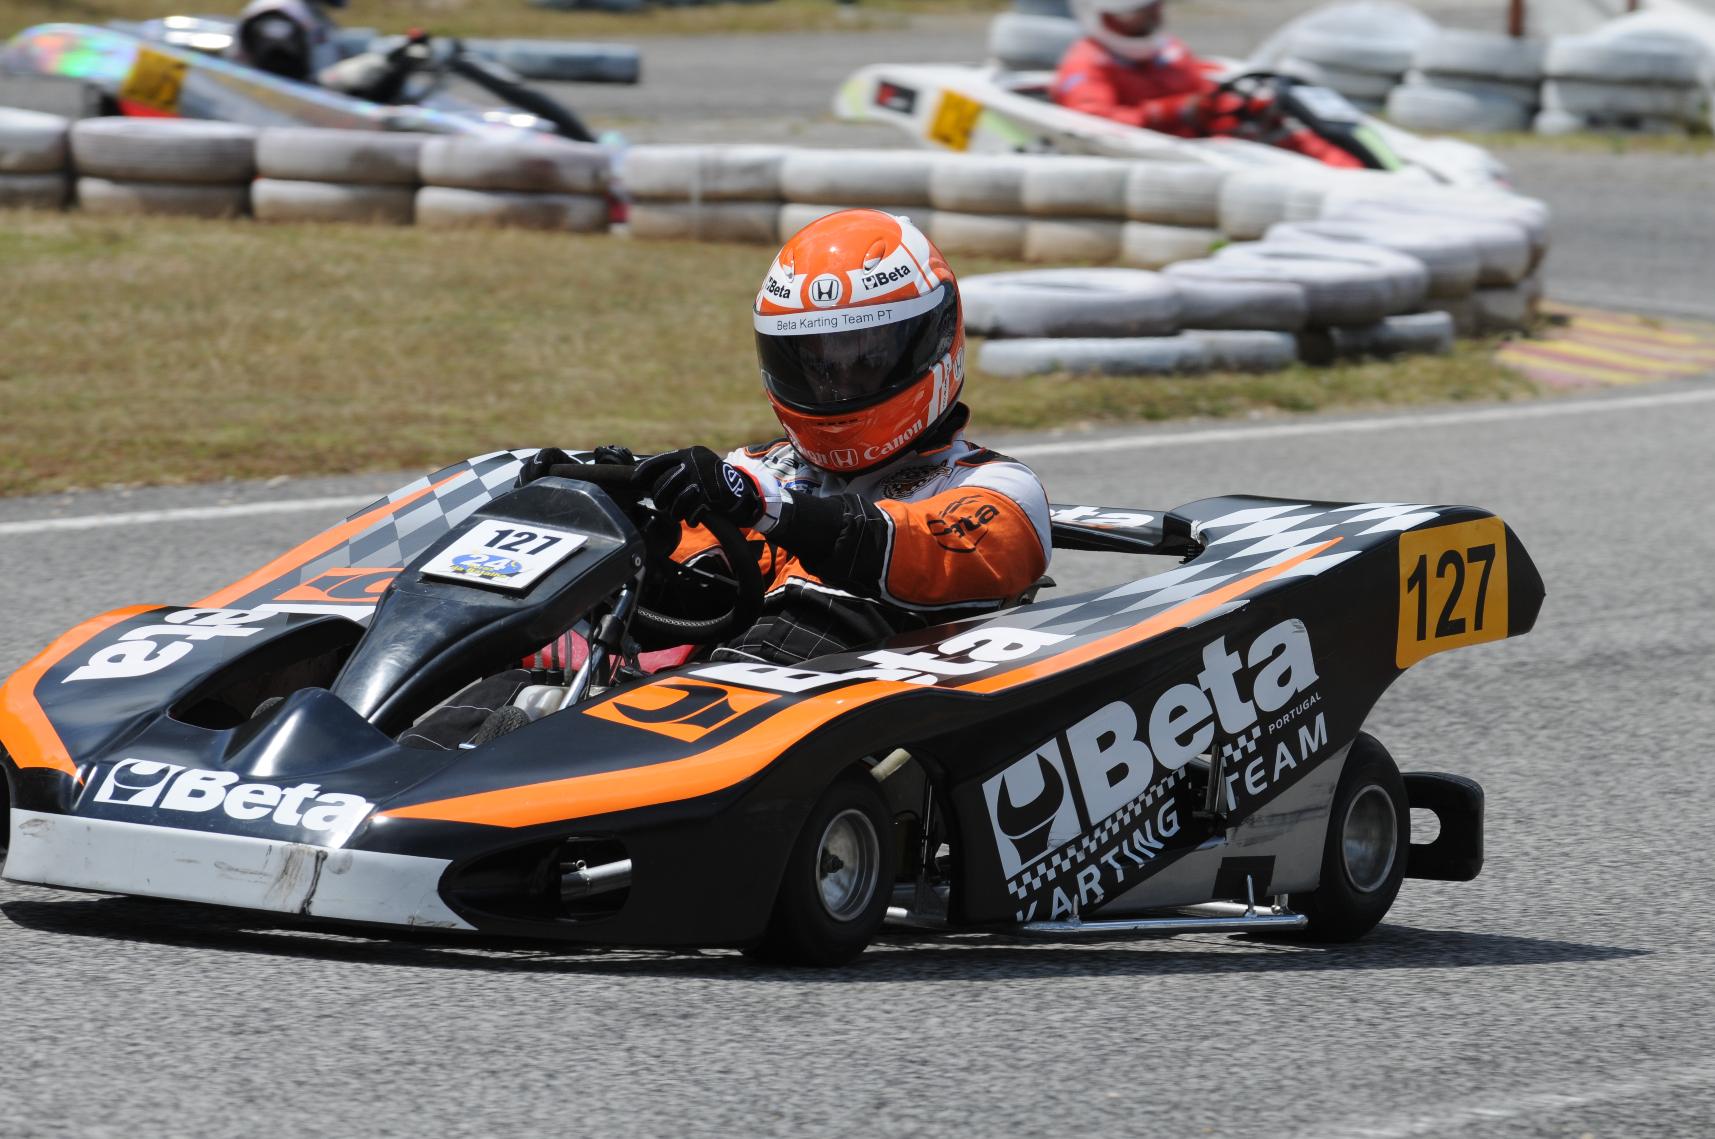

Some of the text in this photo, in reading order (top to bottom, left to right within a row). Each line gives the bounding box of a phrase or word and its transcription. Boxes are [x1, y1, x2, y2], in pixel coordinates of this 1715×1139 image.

[768, 279, 791, 299] Beta
[878, 265, 911, 286] Beta
[776, 309, 893, 331] Beta Karting Team PT
[864, 419, 923, 461] Canon
[484, 528, 562, 556] 127
[1407, 543, 1496, 642] 127
[1066, 618, 1320, 827] Beta
[1268, 691, 1322, 735] PORTUGAL
[1223, 711, 1329, 811] TEAM
[160, 768, 375, 850] Beta
